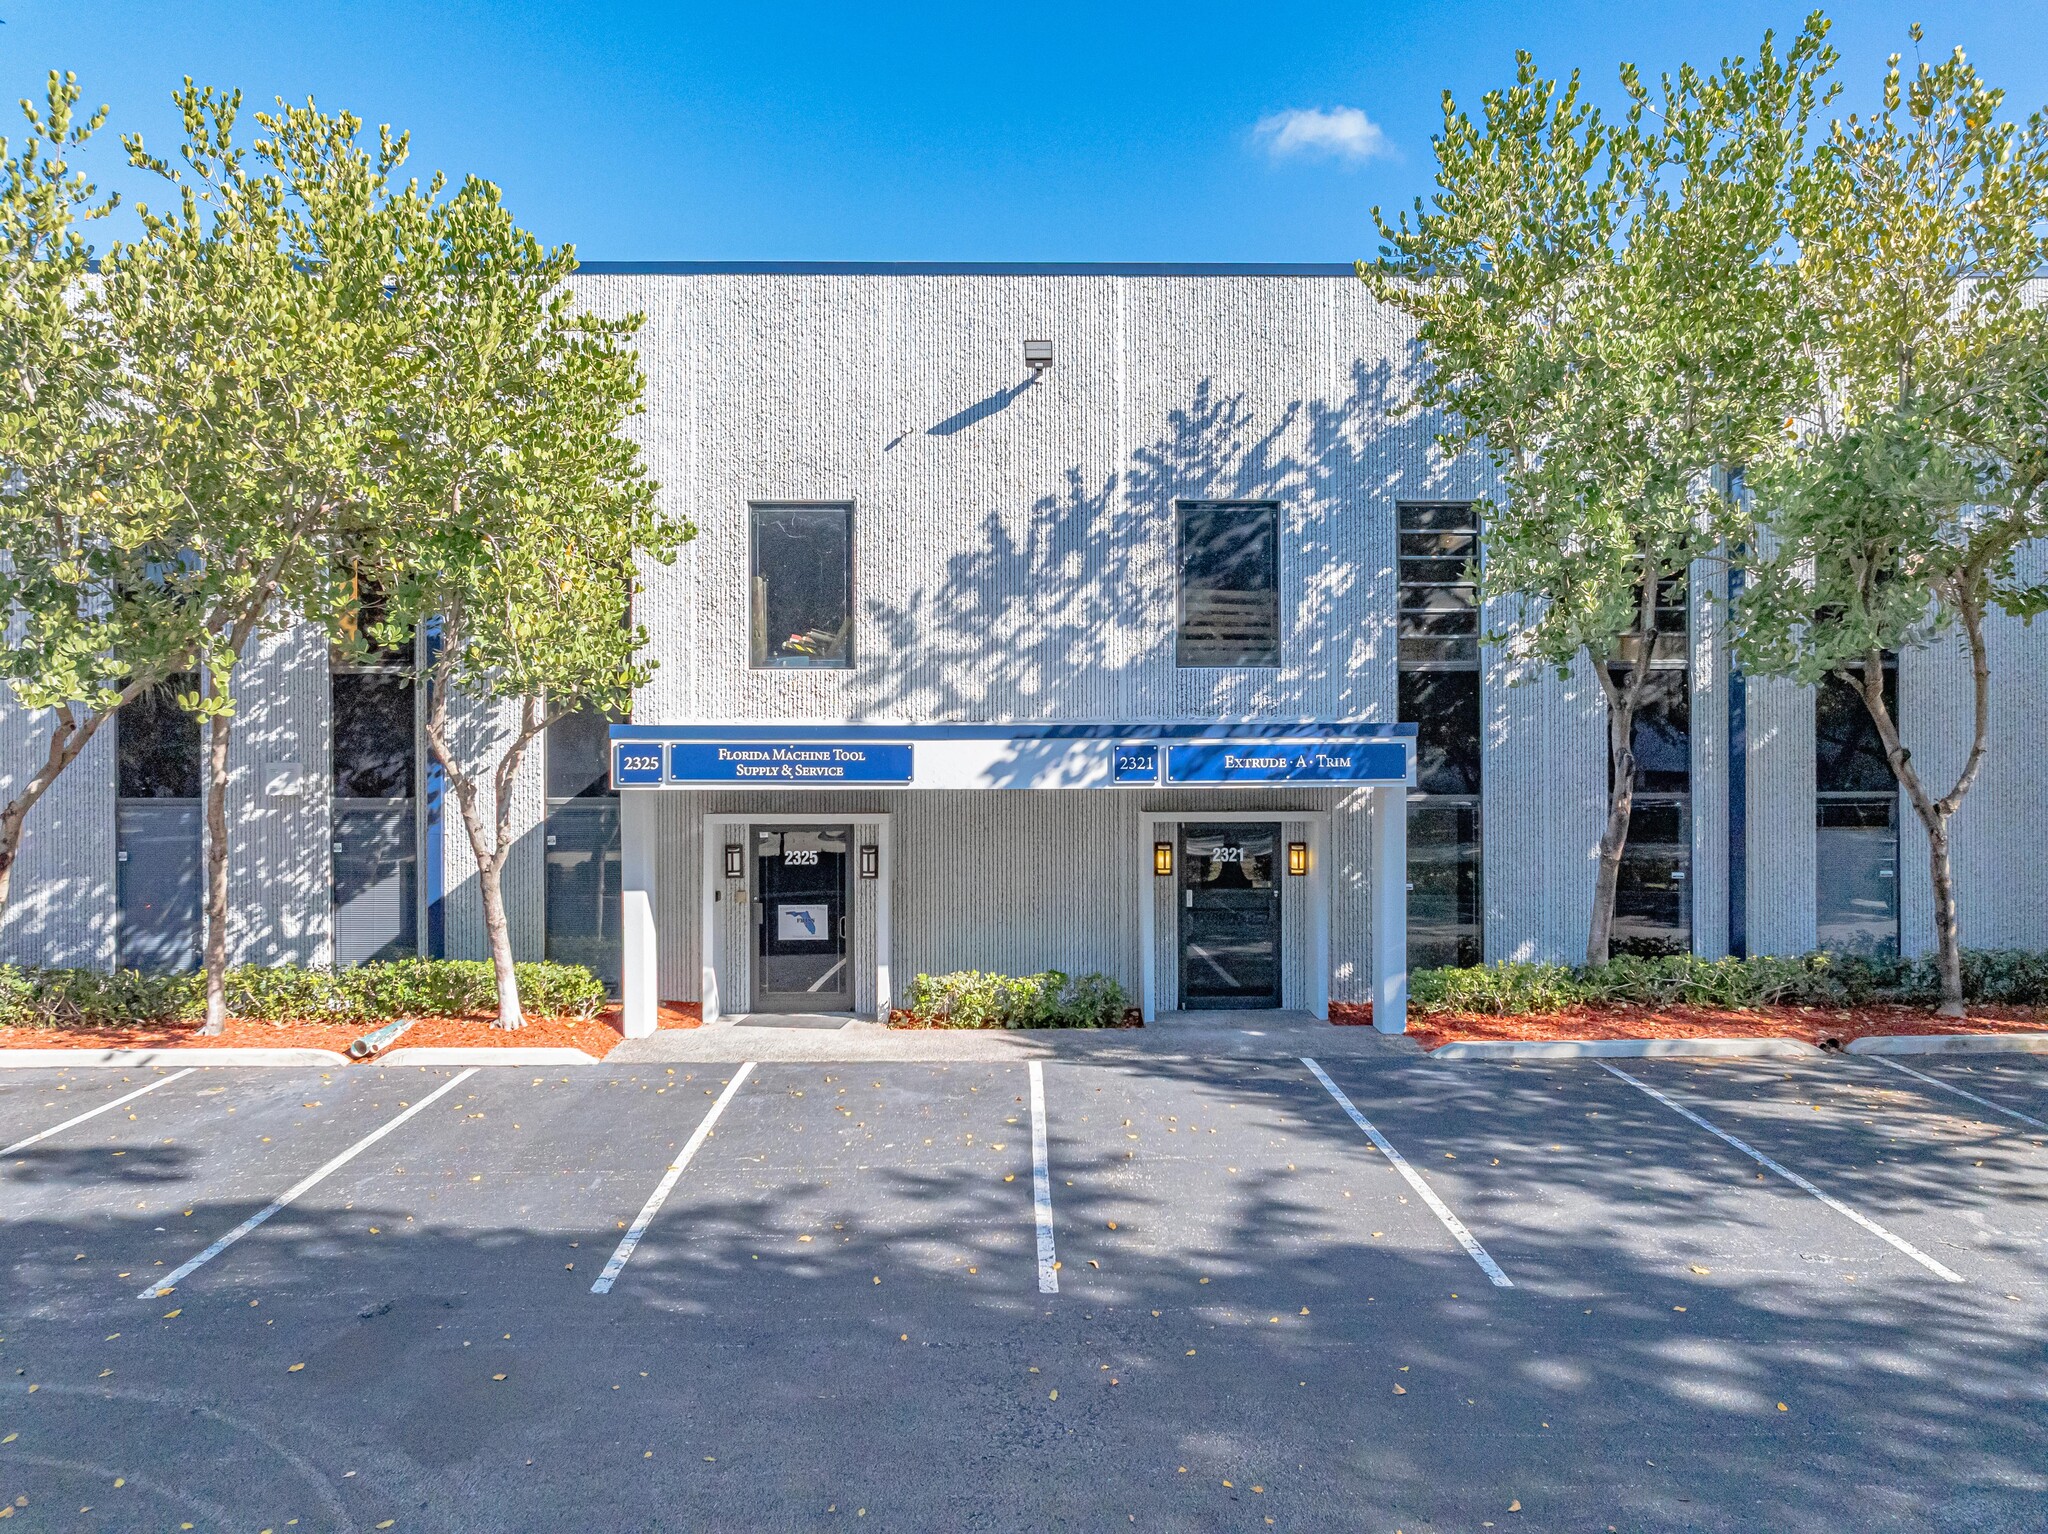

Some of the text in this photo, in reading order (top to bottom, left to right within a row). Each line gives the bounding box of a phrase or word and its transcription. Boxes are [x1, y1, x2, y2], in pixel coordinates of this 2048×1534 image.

[718, 748, 866, 761] FLORIDA MACHINE TOOL
[623, 756, 659, 770] 2325
[1119, 756, 1154, 770] 2321
[736, 764, 844, 777] SUPPLY & SERVICE
[784, 850, 819, 865] 2325
[1211, 847, 1244, 862] 2321
